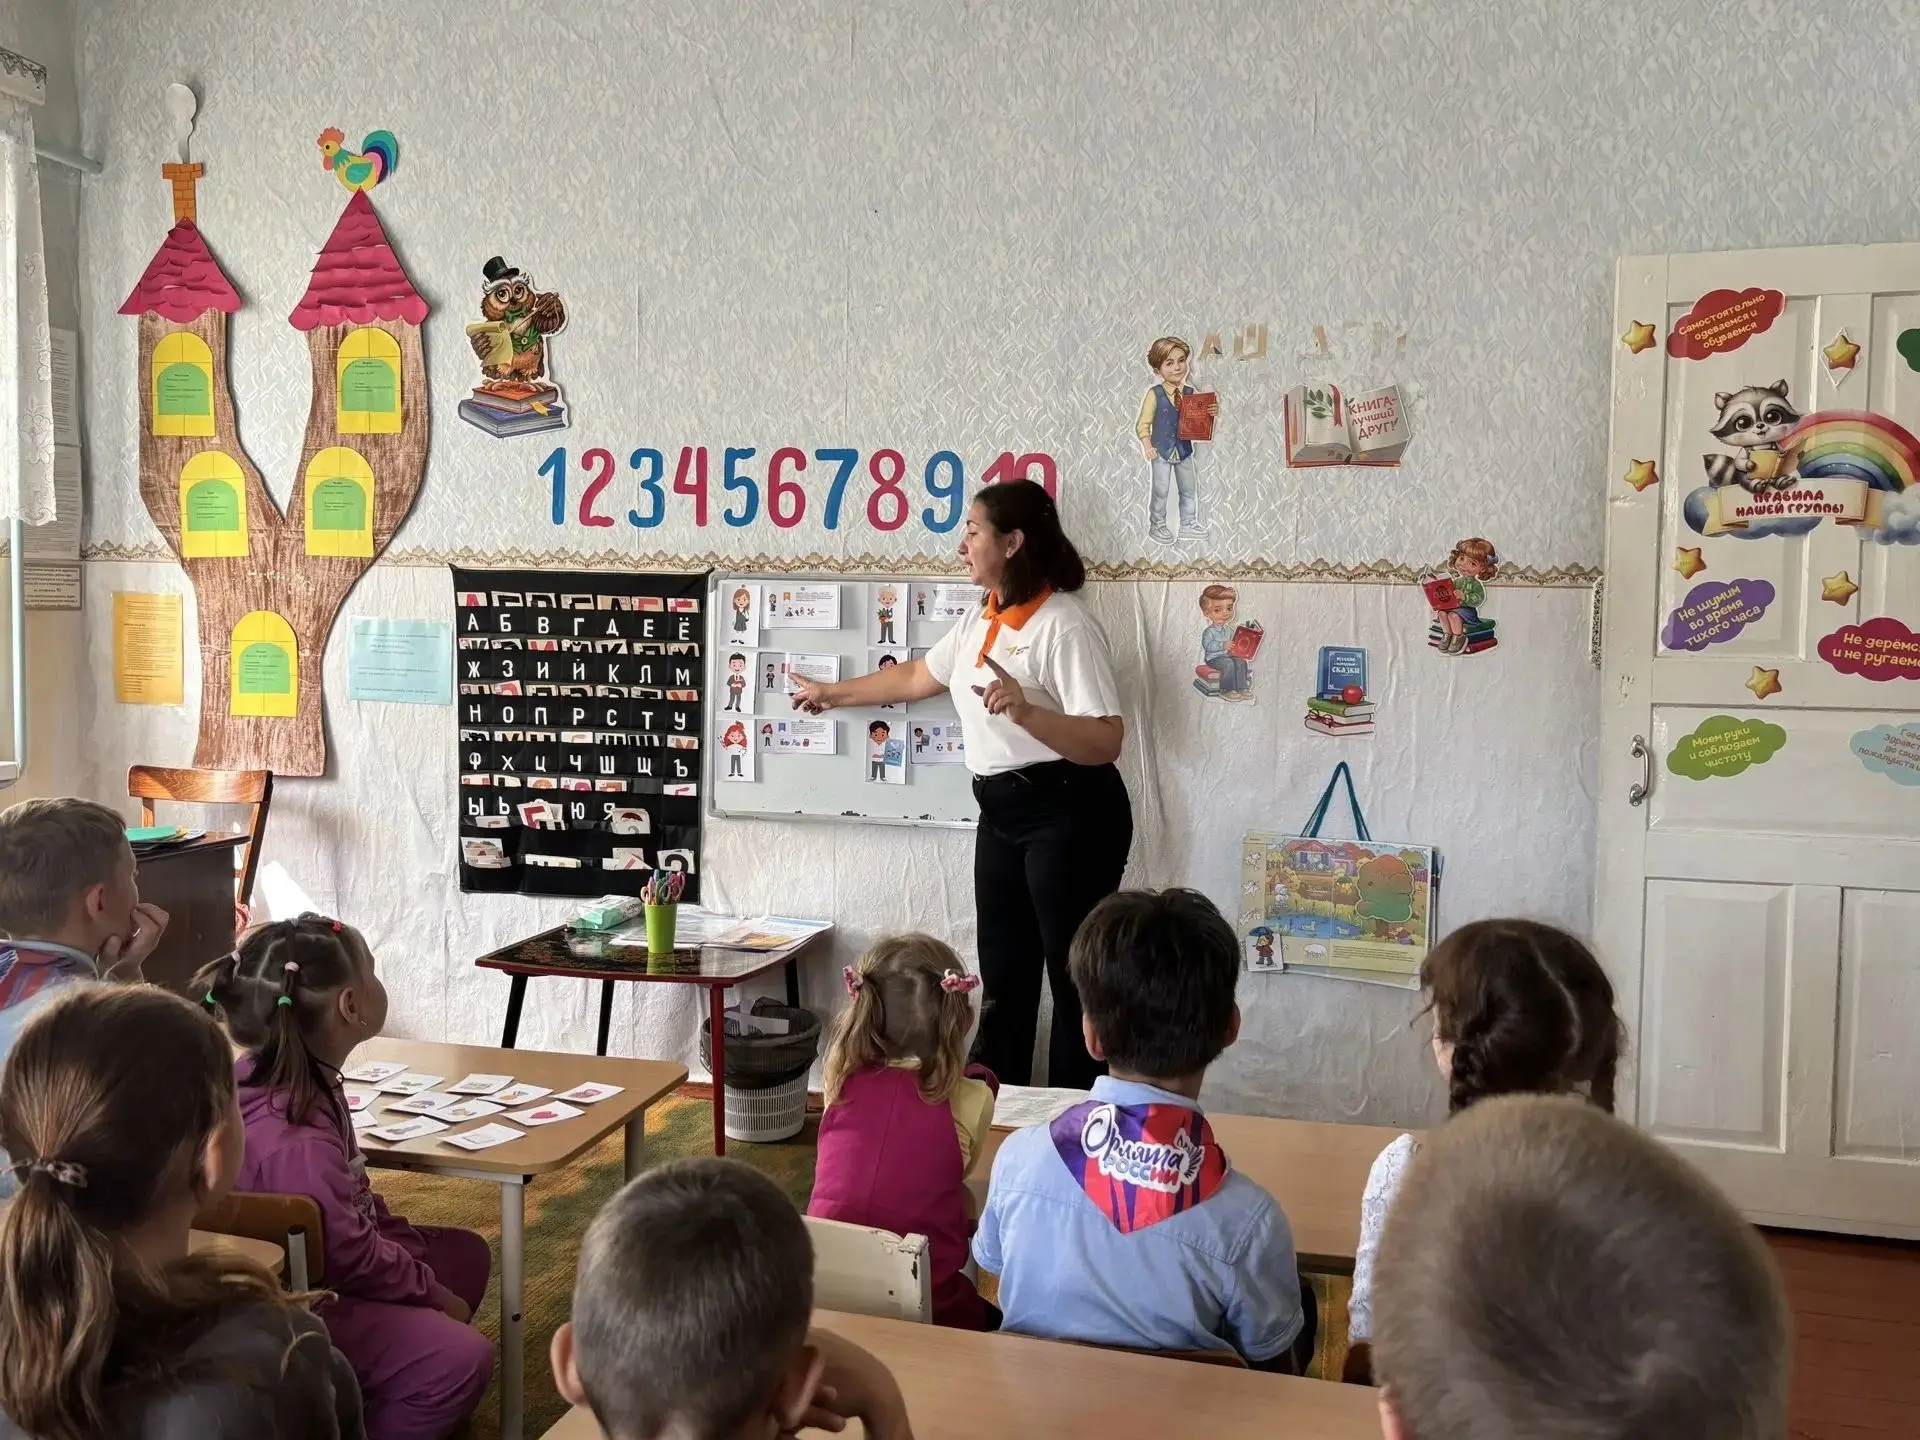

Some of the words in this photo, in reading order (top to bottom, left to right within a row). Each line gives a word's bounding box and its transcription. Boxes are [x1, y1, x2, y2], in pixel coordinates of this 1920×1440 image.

[1679, 294, 1766, 335] Самостоятельно
[1694, 312, 1749, 341] одеваемся
[1750, 309, 1758, 318] и
[1703, 321, 1758, 349] обуваемся
[1348, 396, 1397, 415] КНИГА-
[1352, 407, 1394, 427] лучший
[1359, 419, 1396, 440] ДРУГ!
[538, 446, 566, 526] 1
[579, 447, 616, 528] 2
[628, 447, 666, 528] 3
[673, 446, 708, 527] 4
[723, 447, 759, 528] 5
[767, 447, 807, 529] 6
[814, 447, 860, 530] 7
[867, 448, 909, 532] 8
[922, 450, 965, 535] 9
[1753, 489, 1824, 503] ПРАВИЛА
[1735, 502, 1784, 517] НАШЕЙ
[1787, 503, 1845, 514] ГРУППЫ
[1678, 608, 1697, 622] Не
[1697, 585, 1741, 611] шумим
[1689, 618, 1705, 631] во
[1705, 599, 1744, 623] время
[467, 612, 480, 631] А
[499, 613, 512, 633] Б
[537, 616, 550, 634] В
[573, 617, 585, 636] Г
[605, 618, 620, 637] Д
[643, 618, 654, 638] Е
[678, 616, 690, 641] Ё
[1685, 621, 1730, 646] тихого
[1731, 605, 1761, 622] часа
[1832, 648, 1841, 657] и
[1844, 650, 1861, 660] не
[1843, 632, 1862, 645] Не
[1864, 637, 1920, 653] дерёмс
[467, 661, 481, 678] Ж
[502, 659, 514, 678] З
[537, 661, 549, 679] И
[572, 658, 585, 681] Й
[608, 663, 620, 684] К
[639, 664, 651, 684] Л
[675, 667, 690, 686] М
[469, 703, 482, 723] Н
[502, 705, 514, 724] О
[534, 706, 548, 726] П
[572, 707, 585, 726] Р
[606, 708, 618, 727] С
[641, 710, 654, 730] Т
[674, 711, 686, 731] У
[1689, 752, 1697, 760] и
[1698, 736, 1760, 758] соблюдаем
[1692, 734, 1722, 747] Моем
[1724, 727, 1750, 742] руки
[468, 752, 482, 771] Ф
[501, 754, 515, 771] Х
[535, 755, 547, 773] Ц
[569, 754, 582, 772] Ч
[599, 755, 615, 775] Ш
[637, 756, 652, 777] Щ
[673, 758, 689, 778] Ъ
[1704, 751, 1752, 767] чистоту
[1858, 746, 1915, 769] пожалуйста
[468, 797, 484, 817] Ы
[498, 795, 511, 815] Ь
[570, 801, 585, 820] Ю
[603, 802, 617, 821] Я
[1084, 1107, 1185, 1171] Орлята
[1102, 1155, 1180, 1187] РОССИИ
